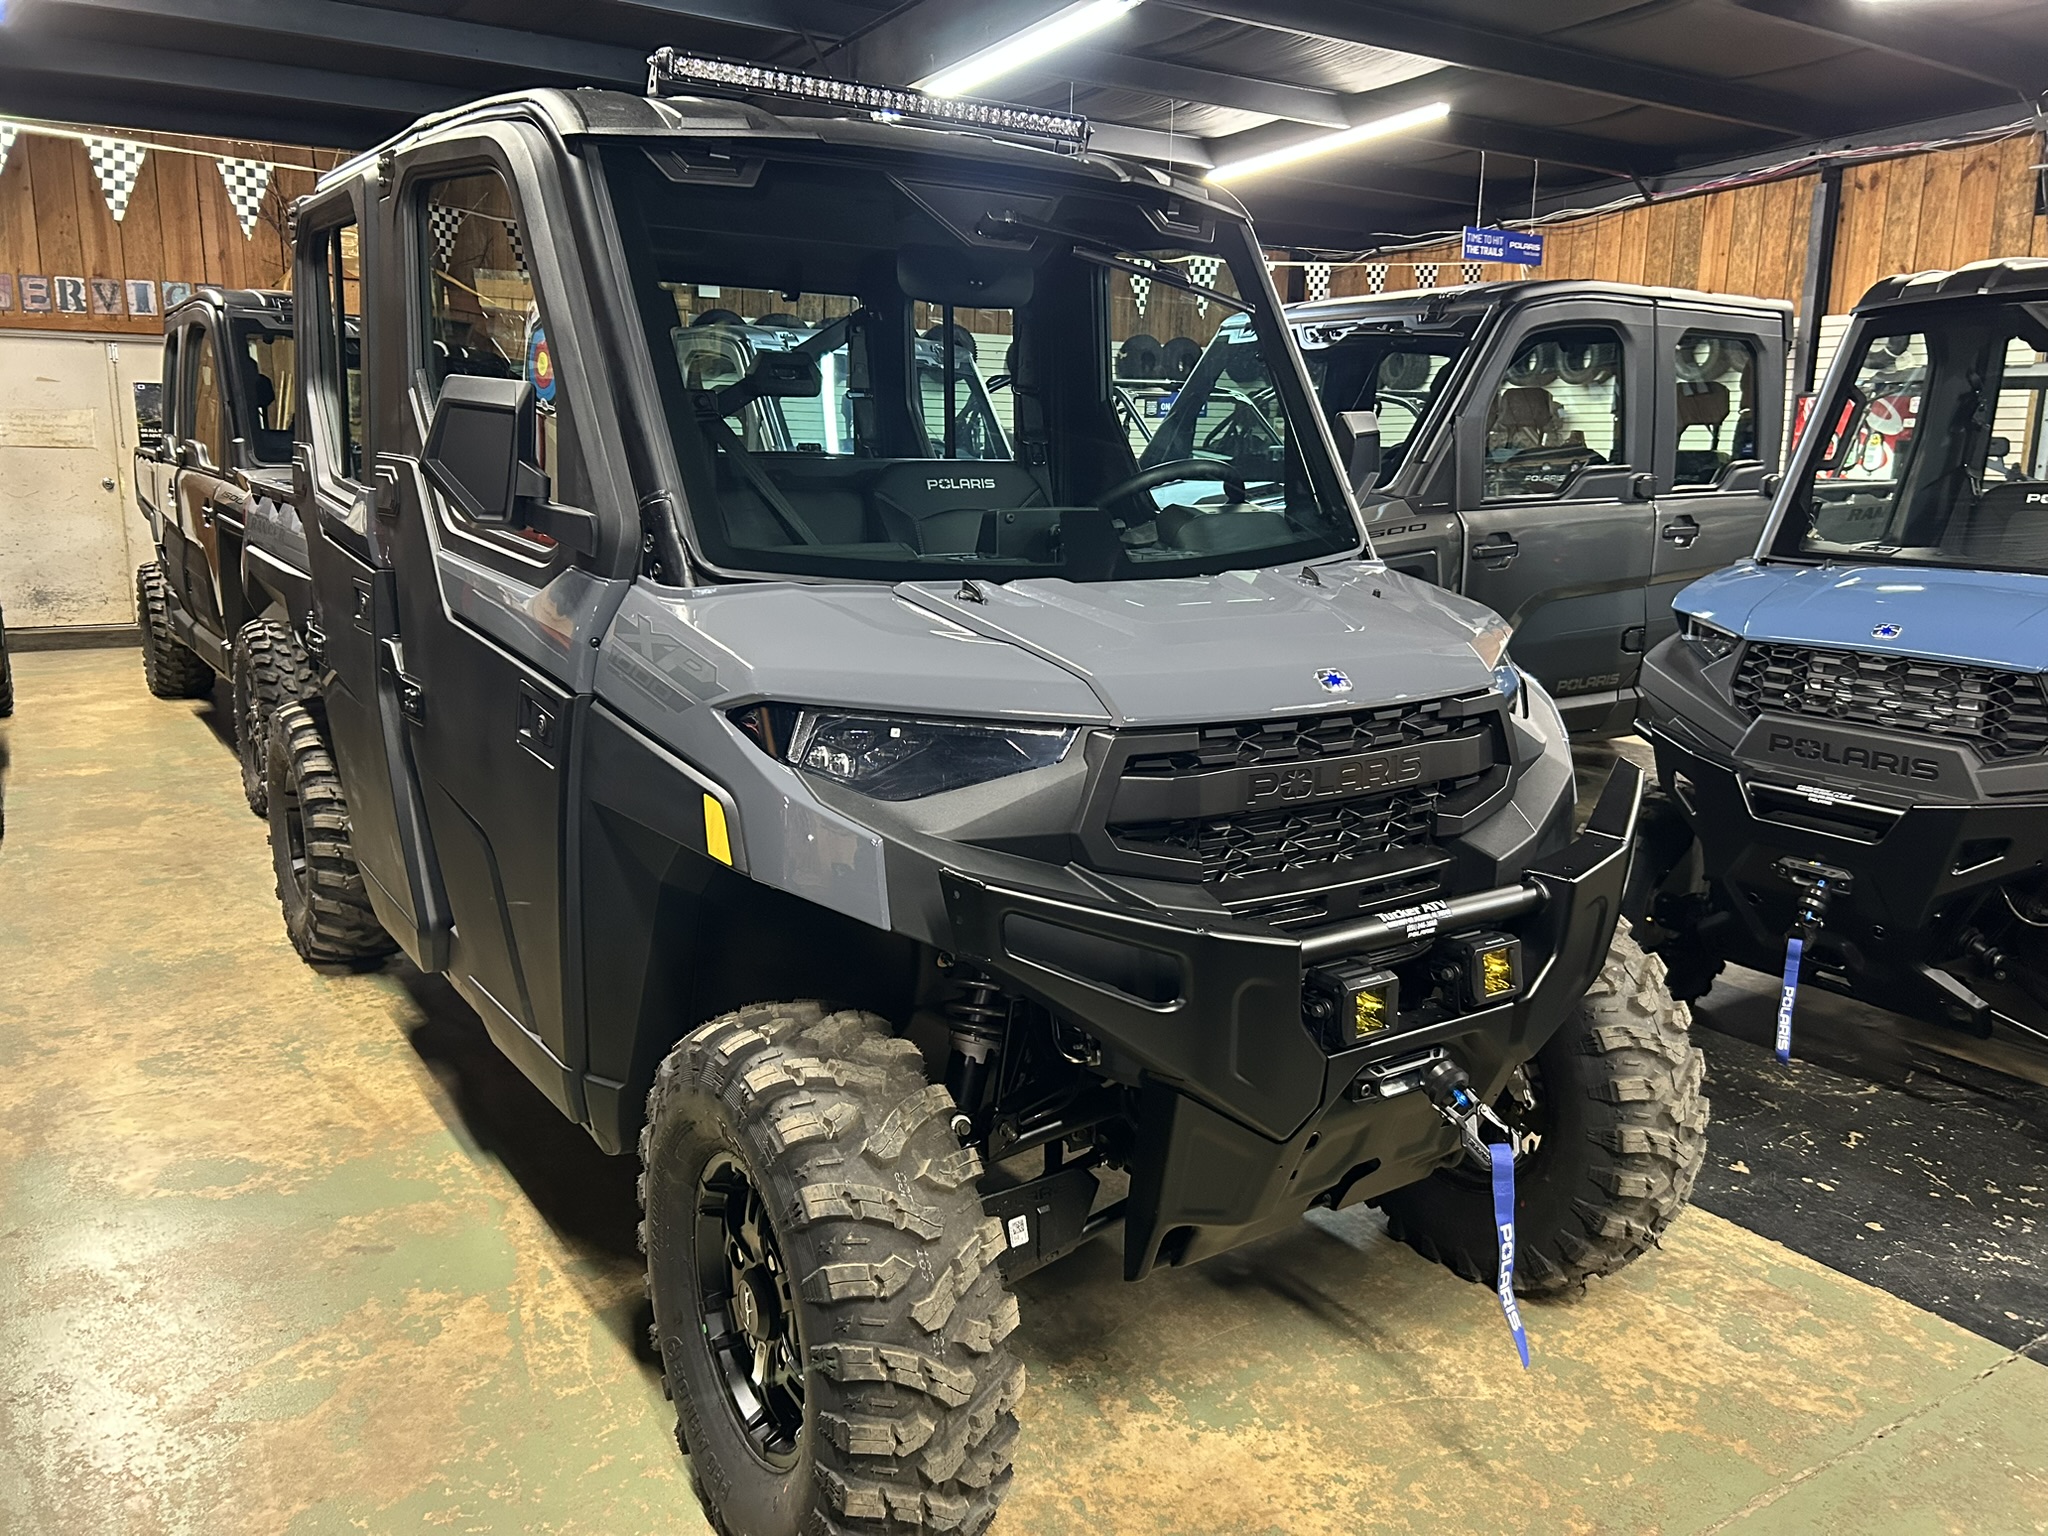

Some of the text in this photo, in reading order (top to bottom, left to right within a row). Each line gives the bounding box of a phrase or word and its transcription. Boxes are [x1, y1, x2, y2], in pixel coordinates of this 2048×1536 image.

[1467, 232, 1504, 246] TIME TO HIT
[1508, 241, 1541, 252] POLARIS
[1466, 244, 1504, 257] THE TRAILS
[926, 478, 996, 490] POLARIS
[2025, 493, 2048, 504] PO
[1368, 523, 1427, 539] 500
[613, 612, 718, 684] XP
[1556, 673, 1620, 693] POLARIS
[1768, 733, 1940, 782] POLARIS
[1247, 751, 1422, 805] POLARIS
[1375, 907, 1421, 922] Tucker
[1421, 899, 1448, 913] ATV
[1777, 986, 1795, 1051] POLARIS
[1499, 1222, 1522, 1332] POLARIS
